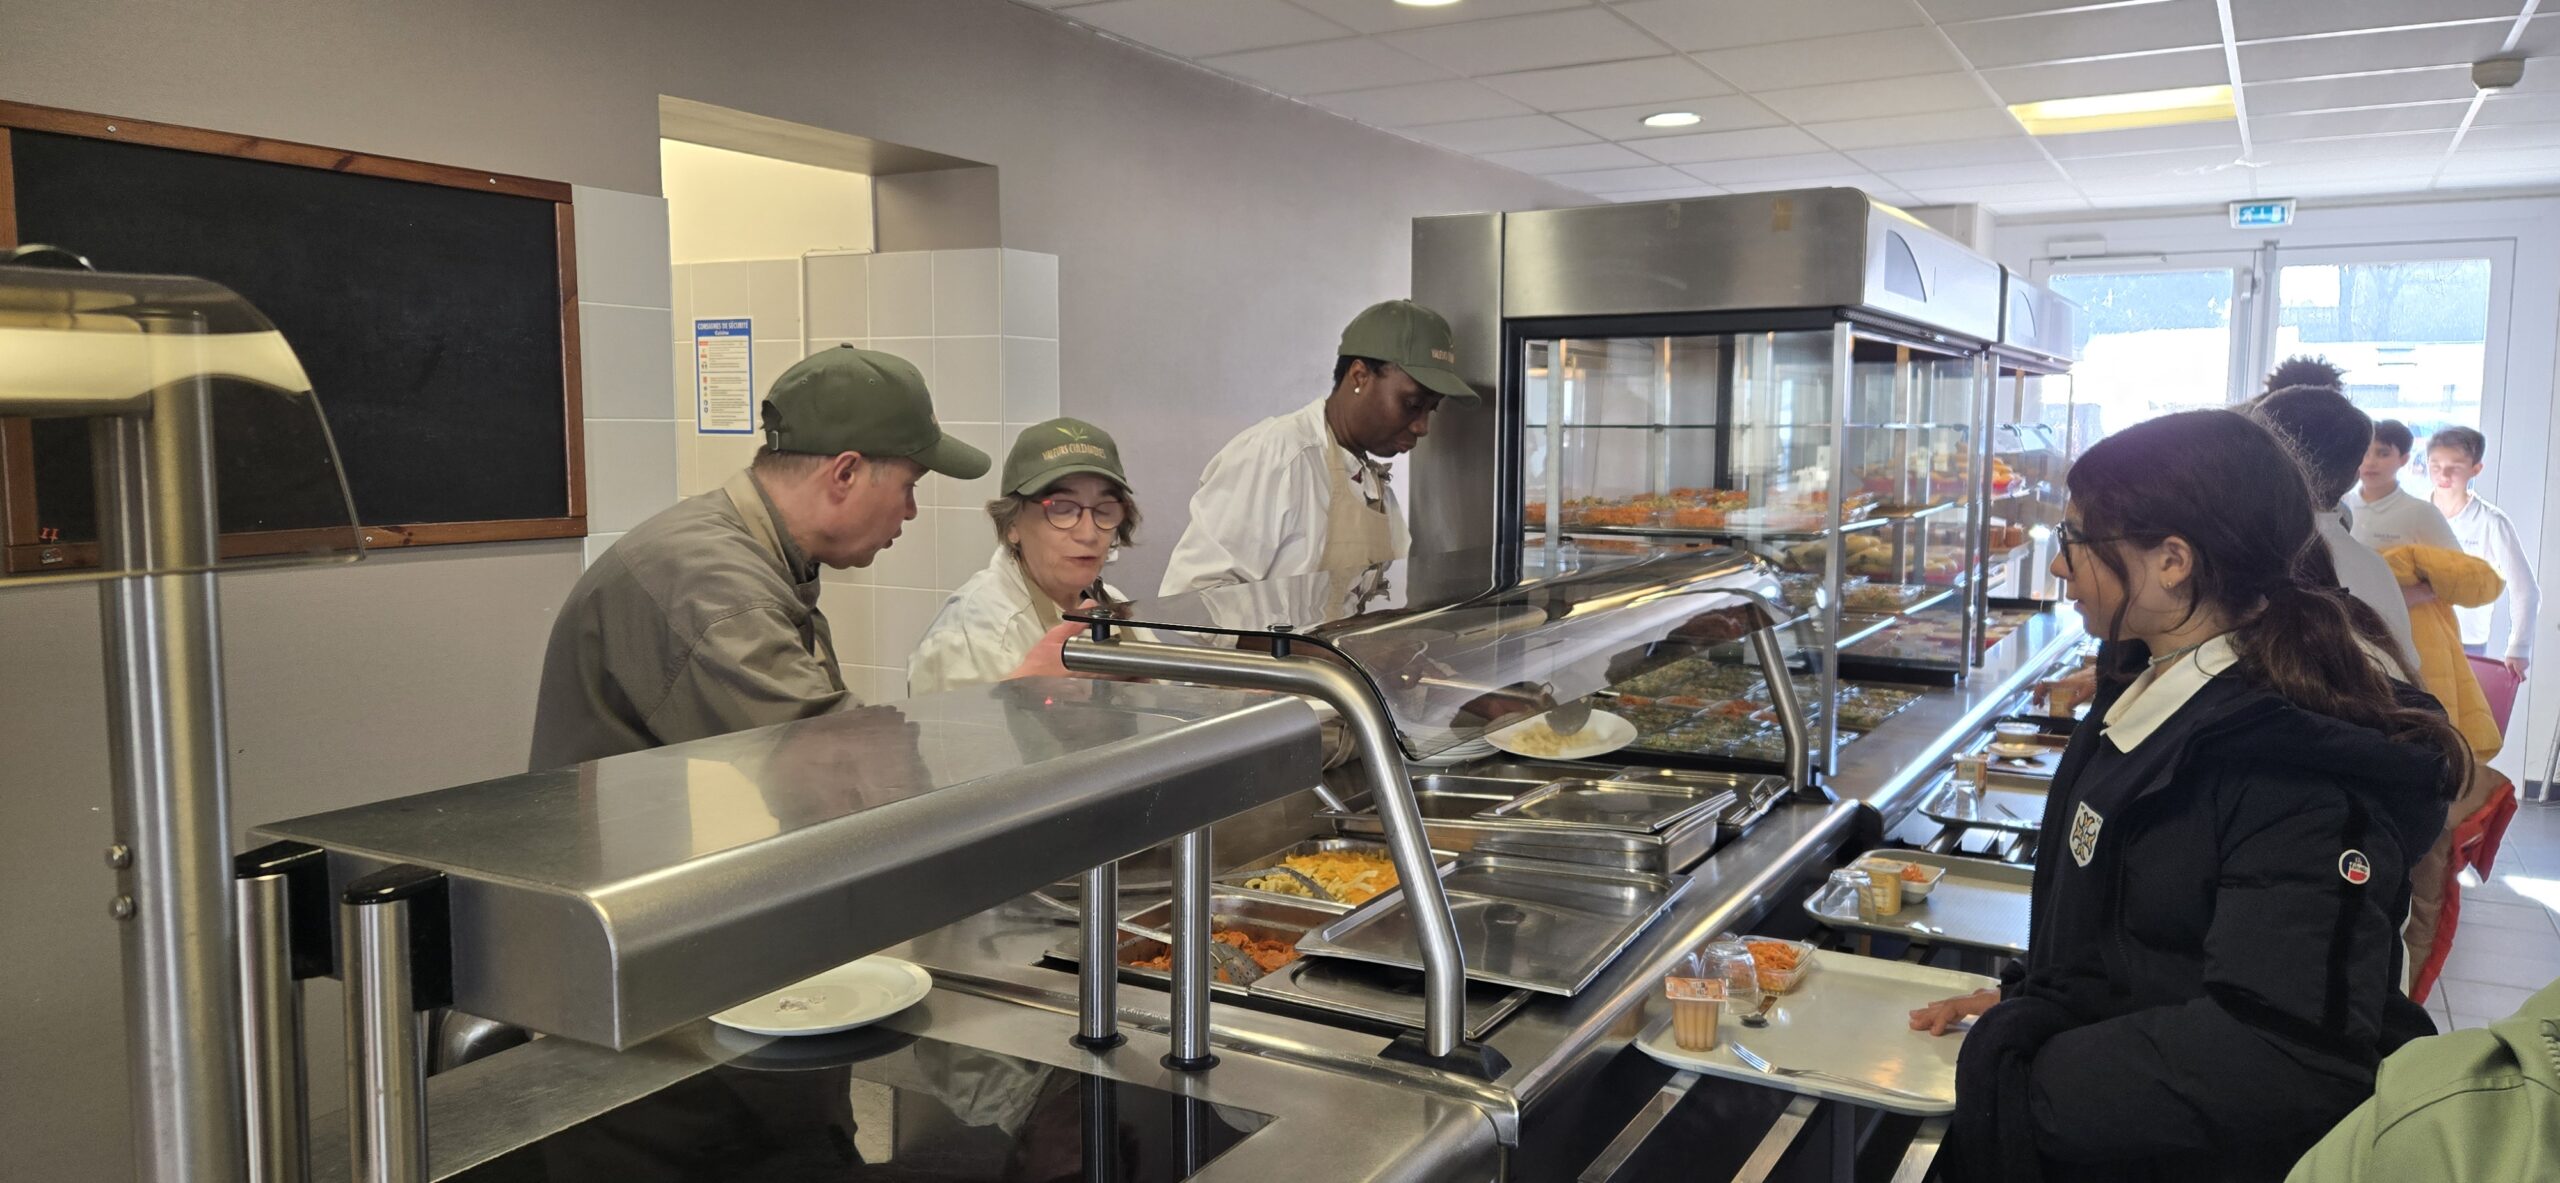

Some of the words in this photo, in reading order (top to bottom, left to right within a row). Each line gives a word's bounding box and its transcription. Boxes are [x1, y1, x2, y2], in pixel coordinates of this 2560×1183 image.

[697, 322, 721, 330] CONSIGNES
[728, 320, 749, 329] SÉCURITÉ
[1042, 444, 1069, 461] VALEURS
